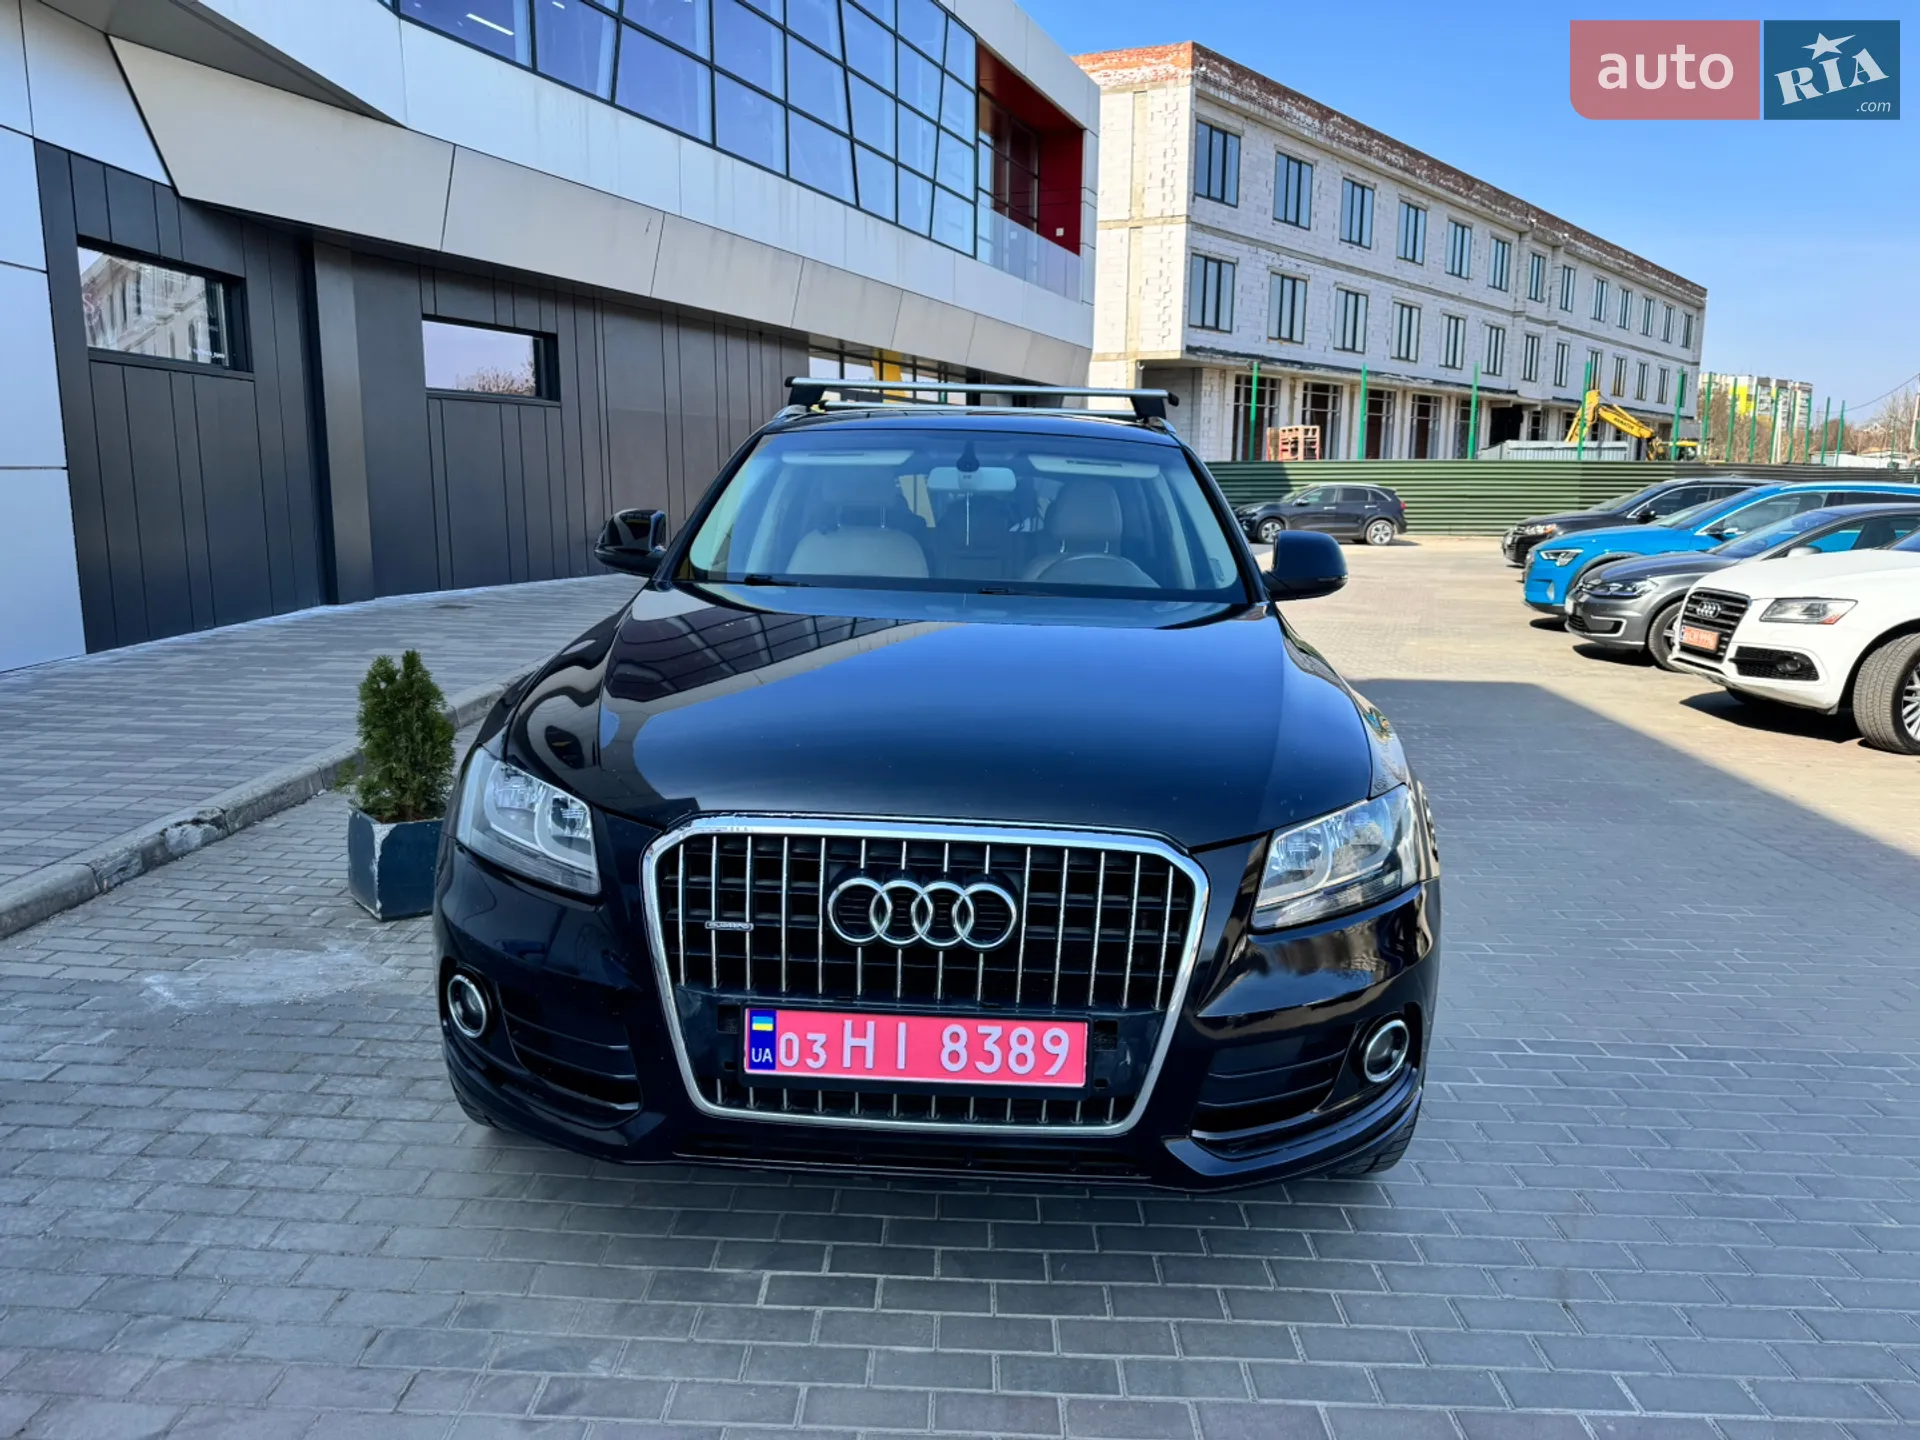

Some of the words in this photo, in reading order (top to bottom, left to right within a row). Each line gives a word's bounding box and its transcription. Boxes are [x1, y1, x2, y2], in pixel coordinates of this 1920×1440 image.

[751, 1047, 773, 1063] UA
[779, 1032, 827, 1069] 03
[940, 1024, 1070, 1076] 8389
